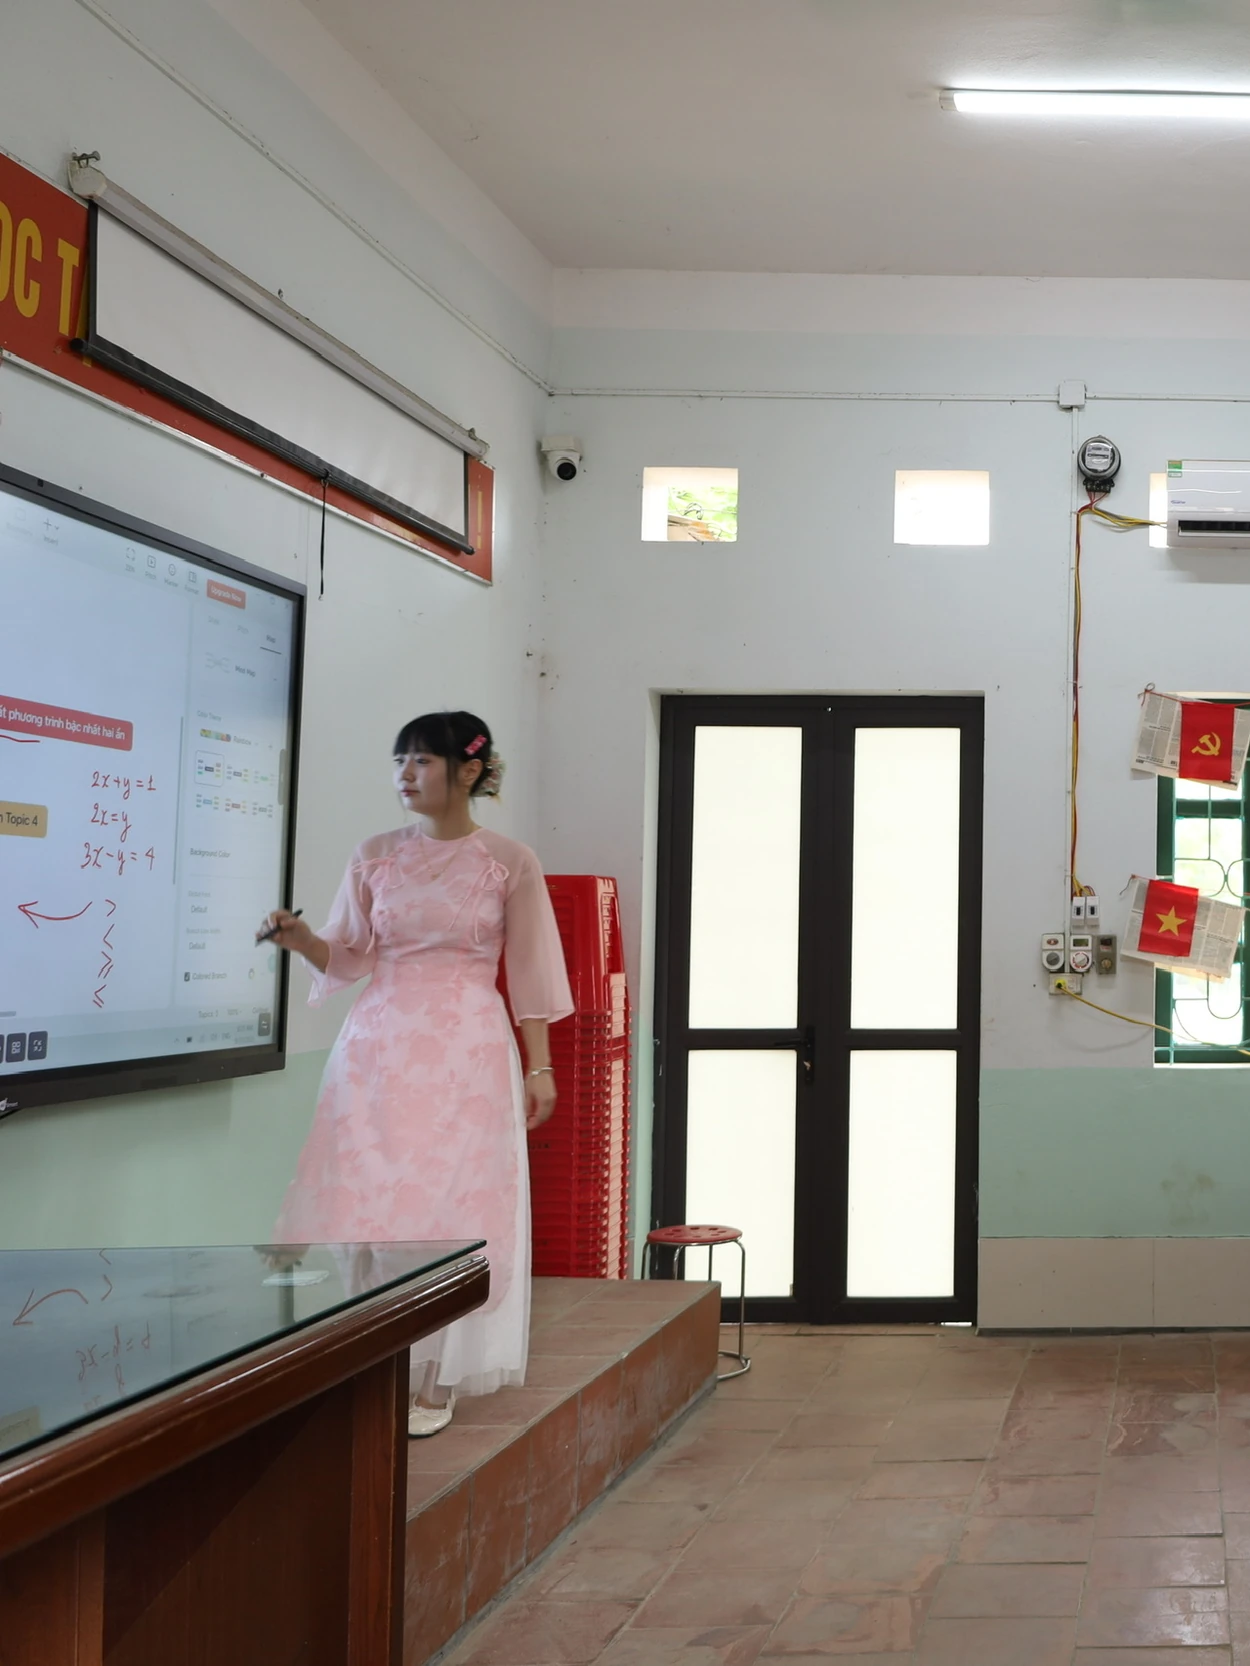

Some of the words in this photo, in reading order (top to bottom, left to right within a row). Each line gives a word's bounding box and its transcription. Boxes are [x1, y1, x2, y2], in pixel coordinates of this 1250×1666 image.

[8, 707, 43, 727] phương
[101, 727, 114, 739] hai
[6, 811, 30, 828] Topic
[31, 815, 38, 827] 4
